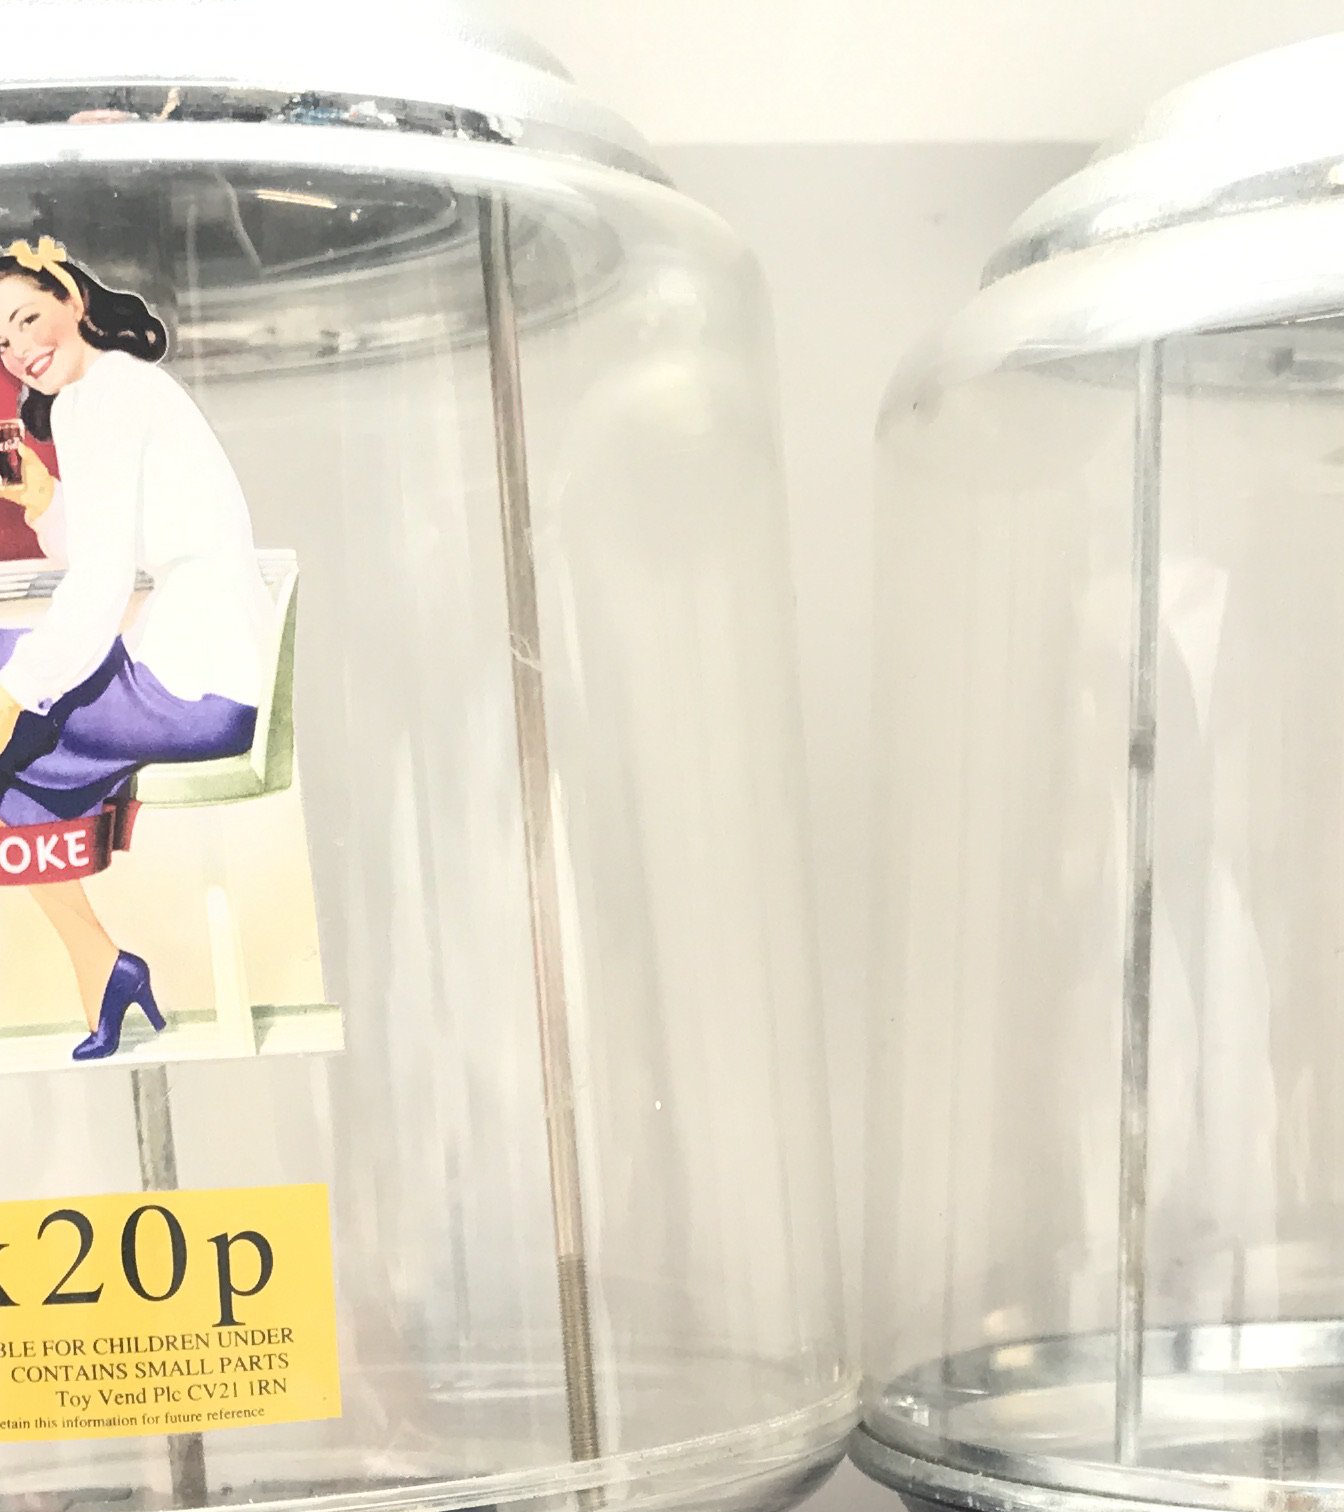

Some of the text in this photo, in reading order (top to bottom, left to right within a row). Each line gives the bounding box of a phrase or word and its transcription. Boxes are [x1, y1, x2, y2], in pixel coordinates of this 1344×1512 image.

[42, 1338, 86, 1357] FOR
[92, 1332, 211, 1355] CHILDREN
[217, 1326, 295, 1349] UNDER
[11, 1361, 128, 1384] CONTAINS
[135, 1358, 214, 1380] SMALL
[219, 1352, 290, 1374] PARTS
[55, 1377, 288, 1411] Toy Vend Plc CV21 1RN
[35, 1415, 58, 1429] this
[62, 1412, 138, 1429] information
[142, 1413, 161, 1426] for
[164, 1411, 202, 1425] future
[206, 1406, 265, 1422] reference
